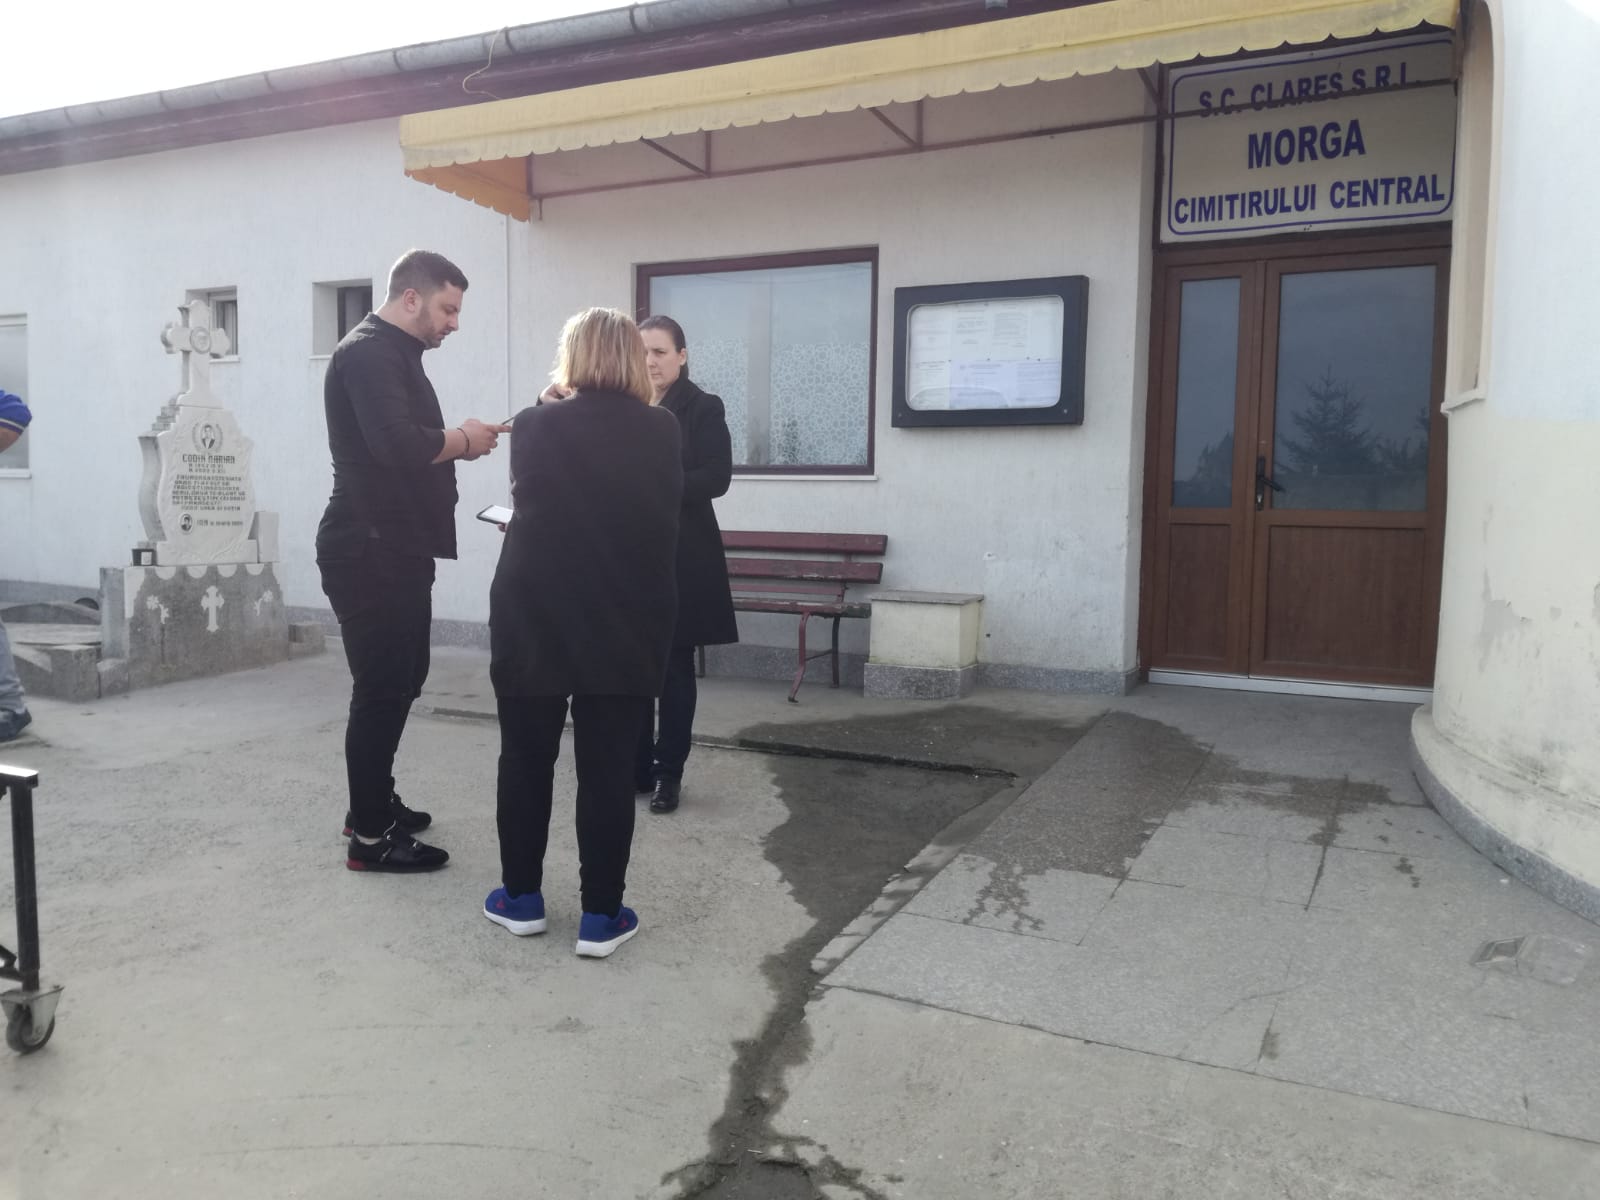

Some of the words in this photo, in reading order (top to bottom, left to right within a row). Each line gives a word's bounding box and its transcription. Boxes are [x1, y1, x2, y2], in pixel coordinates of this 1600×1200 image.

[1250, 72, 1343, 111] CLARES
[1248, 119, 1366, 170] MORGA
[1174, 184, 1317, 225] CIMITIRULUI
[1330, 174, 1445, 210] CENTRAL
